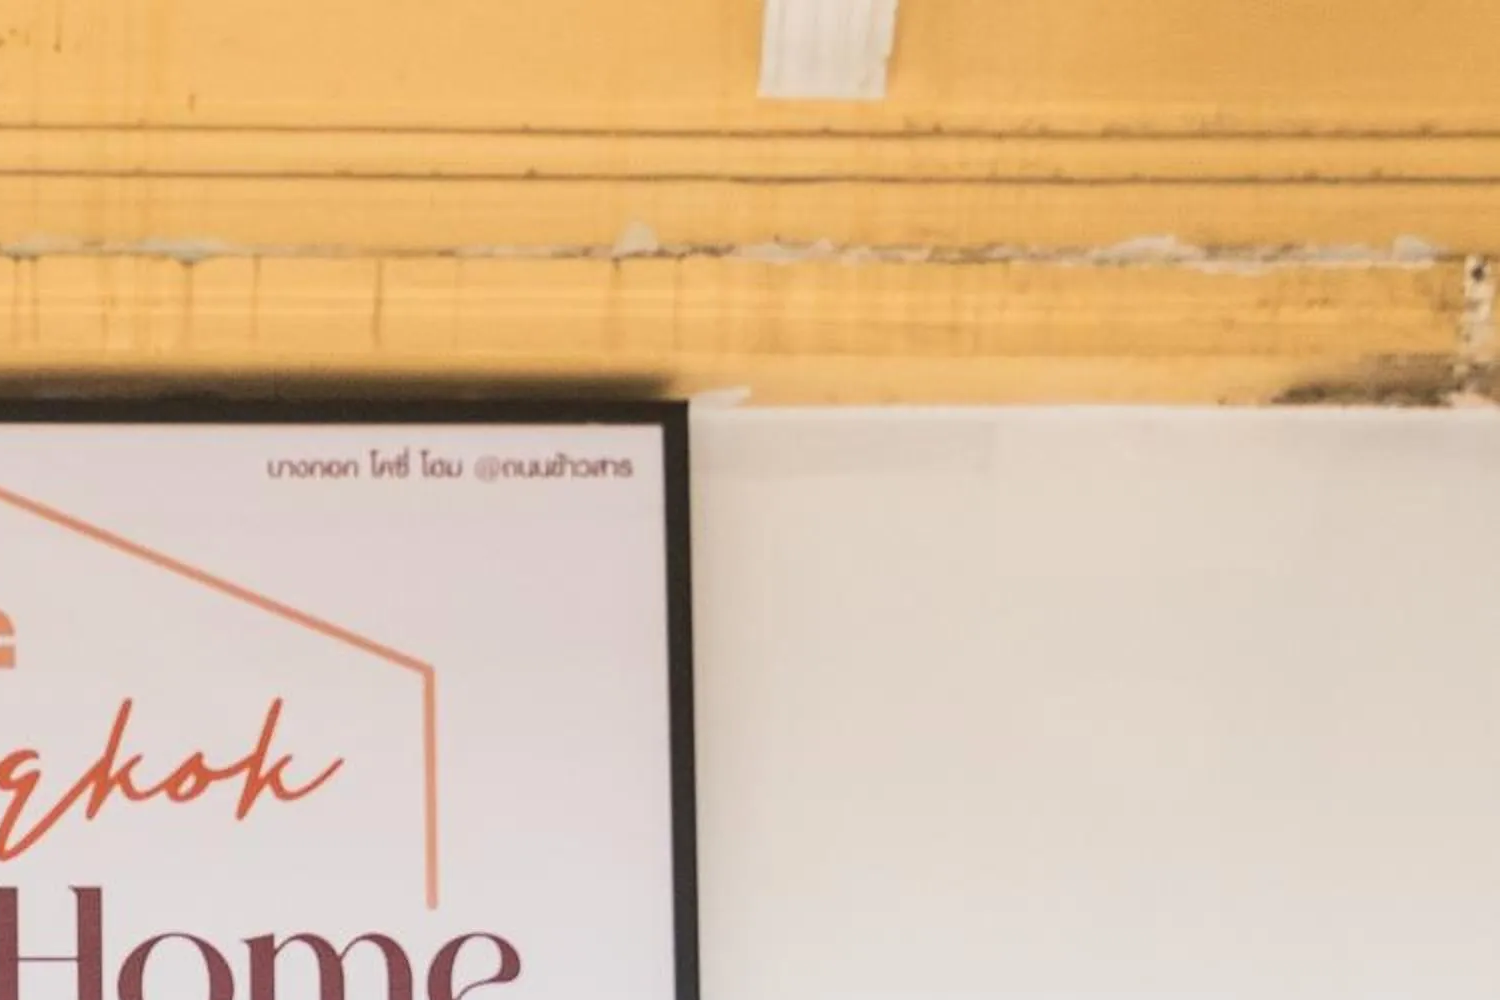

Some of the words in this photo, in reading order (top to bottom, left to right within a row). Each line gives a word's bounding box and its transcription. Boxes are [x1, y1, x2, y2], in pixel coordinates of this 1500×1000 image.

[267, 458, 359, 479] บางกอก
[420, 449, 463, 479] โฮม
[474, 450, 634, 482] @ถนนข้าวสาร
